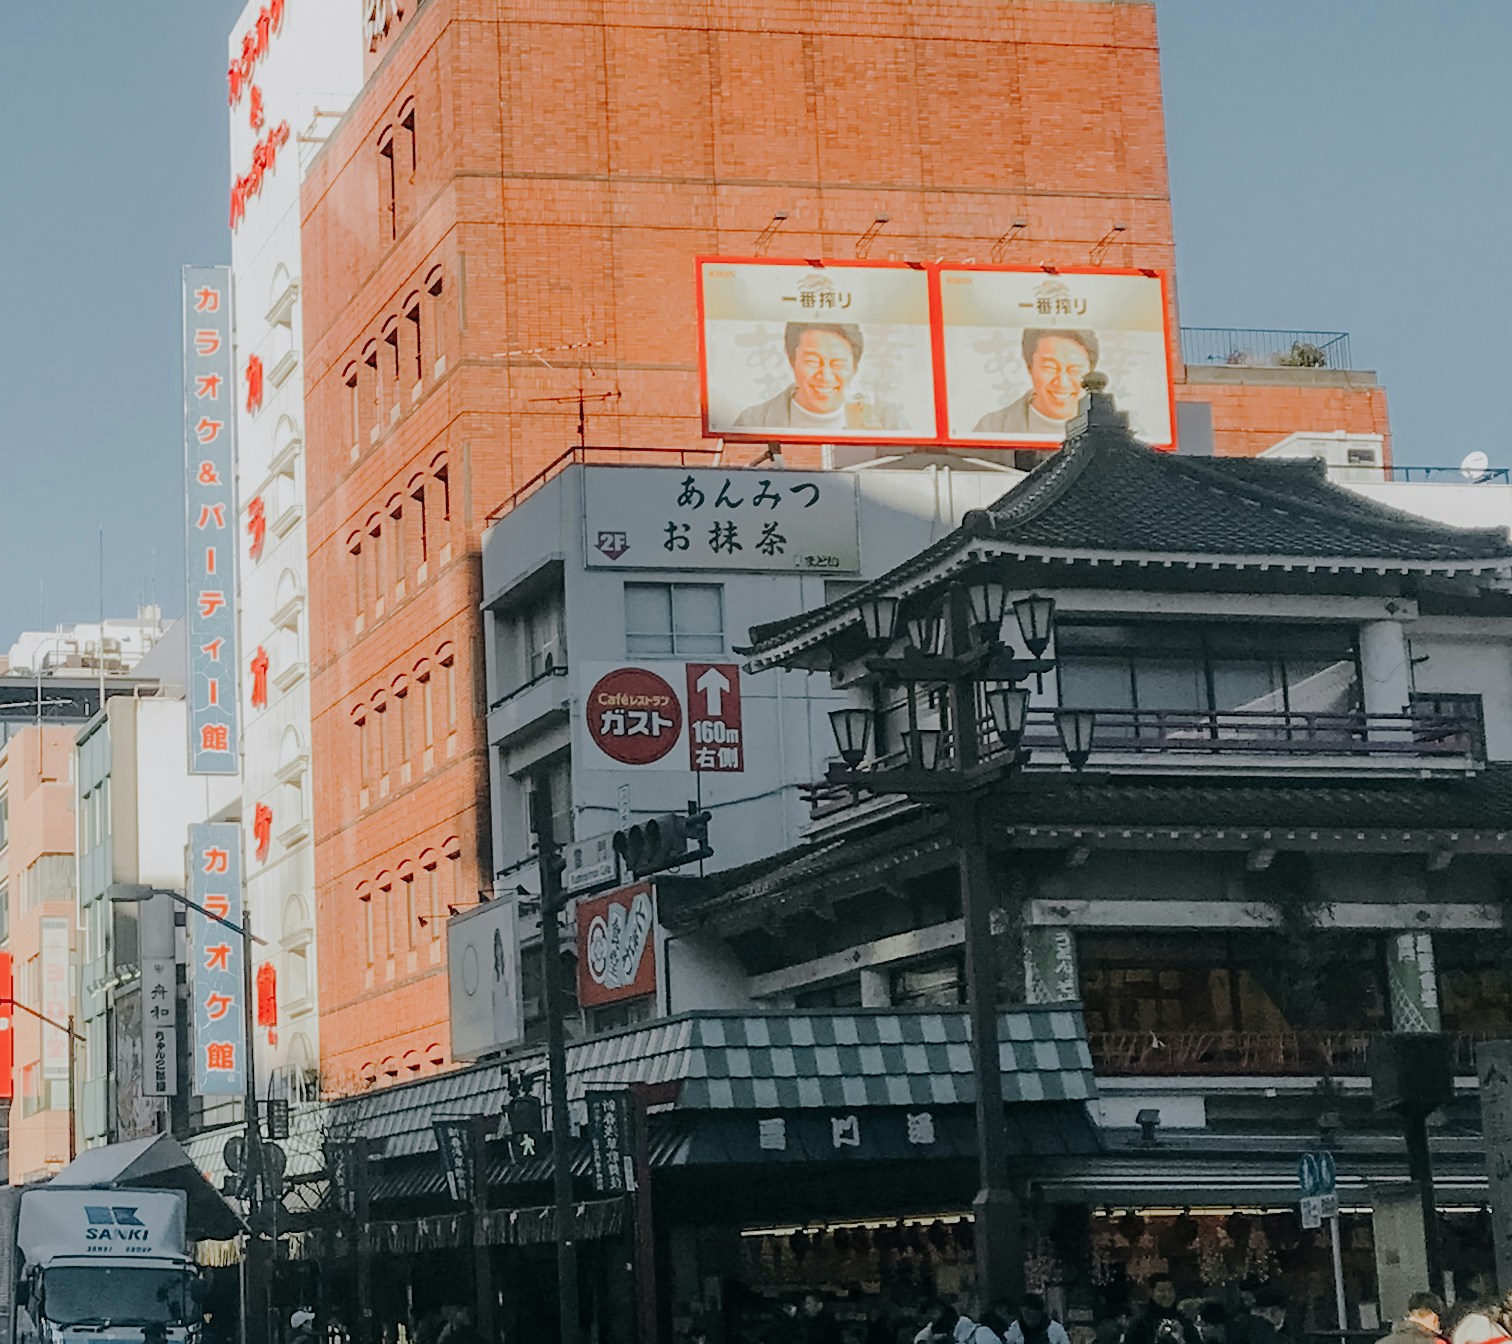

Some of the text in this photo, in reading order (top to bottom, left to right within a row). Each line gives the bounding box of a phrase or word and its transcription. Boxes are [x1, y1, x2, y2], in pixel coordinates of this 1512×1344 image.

[781, 291, 852, 309] 一番搾り
[1018, 297, 1087, 316] 一番搾り
[677, 474, 820, 510] あんみつ
[194, 285, 230, 754] カラオケ&パーティー館
[598, 533, 627, 552] 2F
[663, 520, 787, 556] お抹茶
[600, 709, 673, 737] ガスト
[691, 720, 739, 744] 160m
[695, 746, 738, 769] 右側
[202, 846, 235, 1071] カラオケ館
[85, 1228, 149, 1241] SANKI
